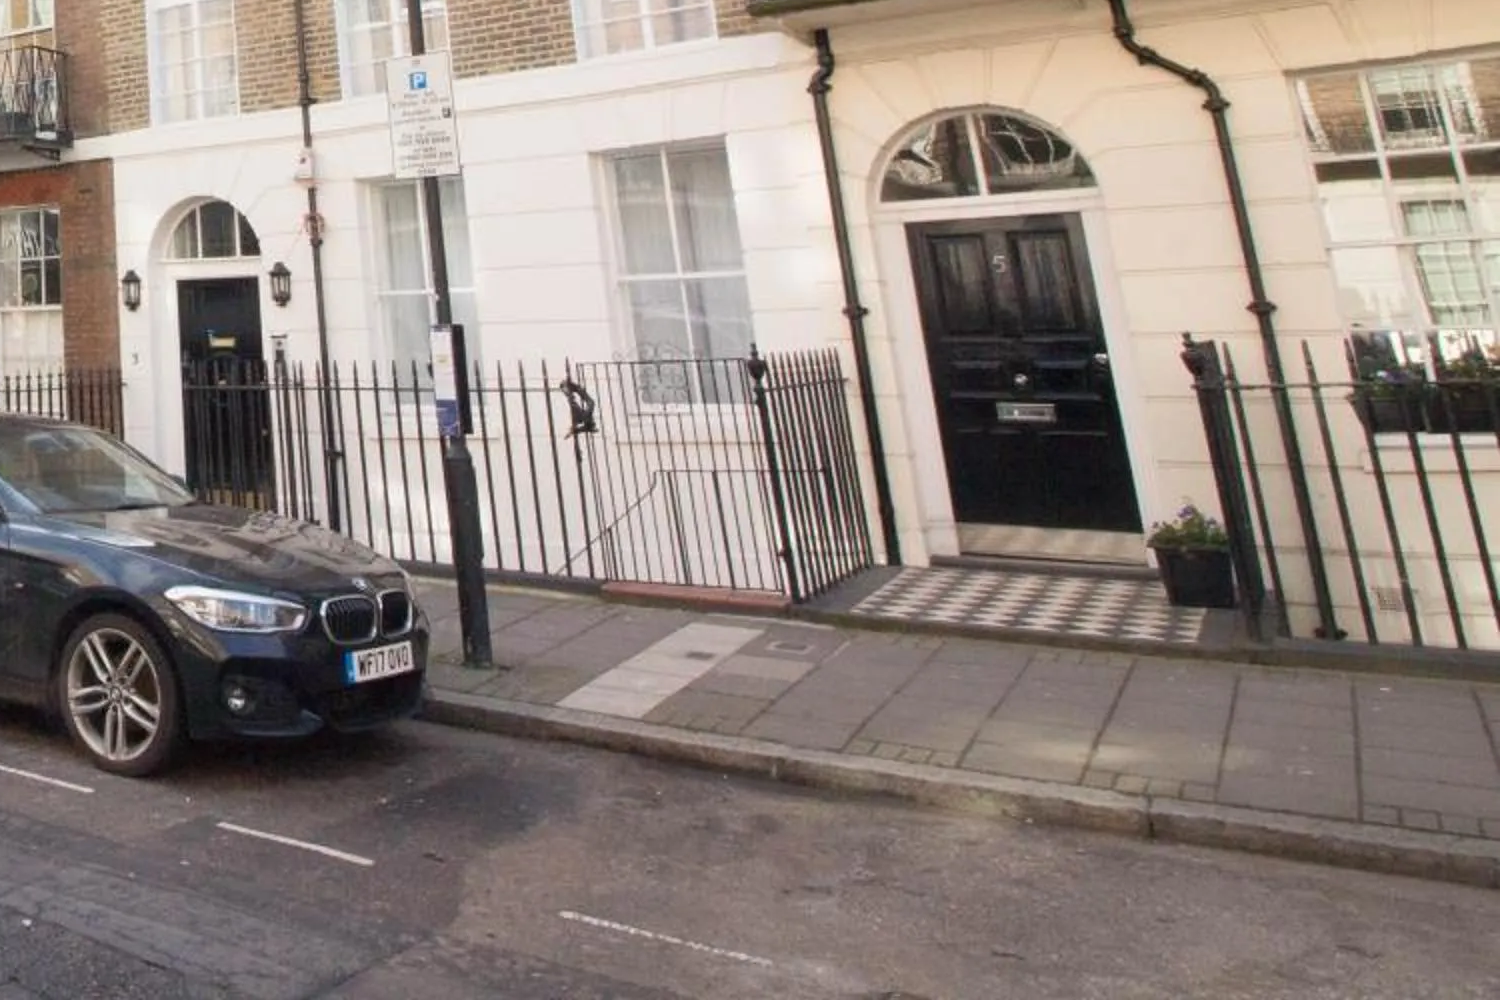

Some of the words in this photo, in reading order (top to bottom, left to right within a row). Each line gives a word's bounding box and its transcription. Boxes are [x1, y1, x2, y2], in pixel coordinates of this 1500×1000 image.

[412, 72, 424, 89] P
[992, 254, 1006, 273] 5
[357, 651, 385, 677] WF17
